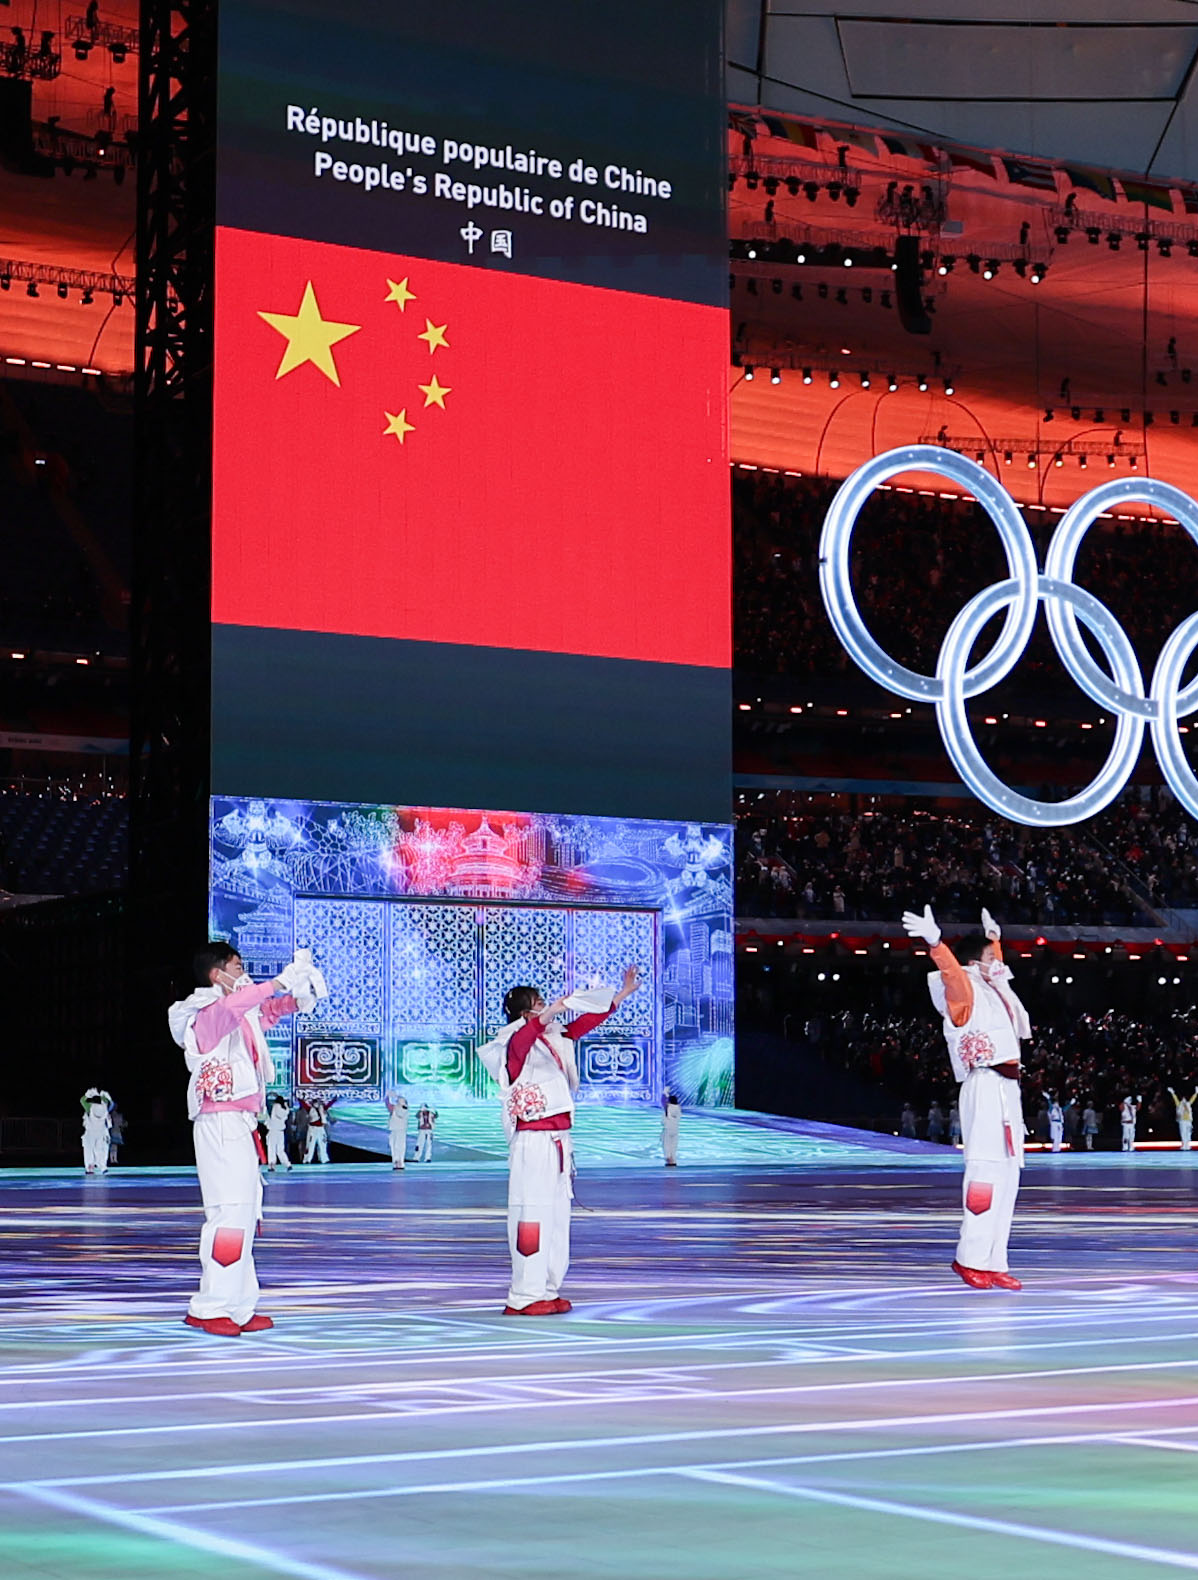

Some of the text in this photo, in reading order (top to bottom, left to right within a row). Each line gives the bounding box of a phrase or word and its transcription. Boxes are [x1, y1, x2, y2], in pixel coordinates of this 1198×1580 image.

[287, 104, 672, 199] République populaire de Chine
[314, 151, 647, 233] People's Republic of China
[460, 220, 513, 259] 中国
